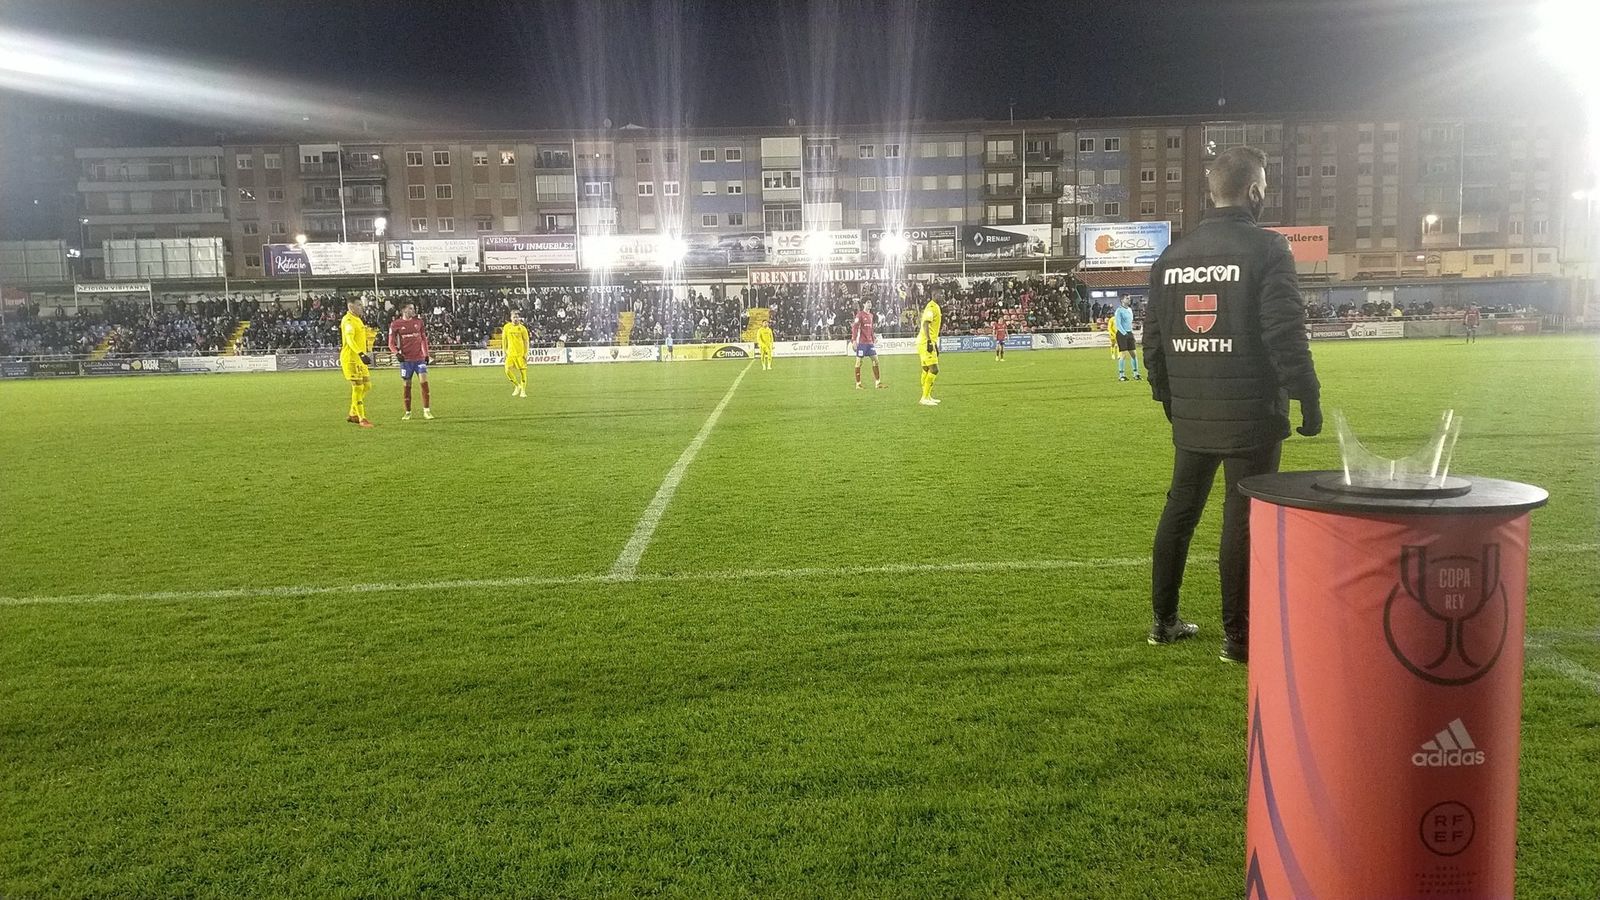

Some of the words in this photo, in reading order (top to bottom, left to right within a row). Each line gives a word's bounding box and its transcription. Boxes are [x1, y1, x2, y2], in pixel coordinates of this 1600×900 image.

[1284, 234, 1324, 242] alleres
[513, 243, 524, 251] TU
[526, 242, 574, 250] INMUEBLE?
[752, 270, 808, 284] FRENTE
[823, 268, 891, 282] MUDEJAR
[1164, 265, 1240, 285] macron
[1172, 338, 1233, 352] WÜRTH
[716, 349, 744, 358] embou
[1439, 568, 1471, 588] COPA
[1445, 594, 1465, 610] REY
[1412, 749, 1486, 768] adidas
